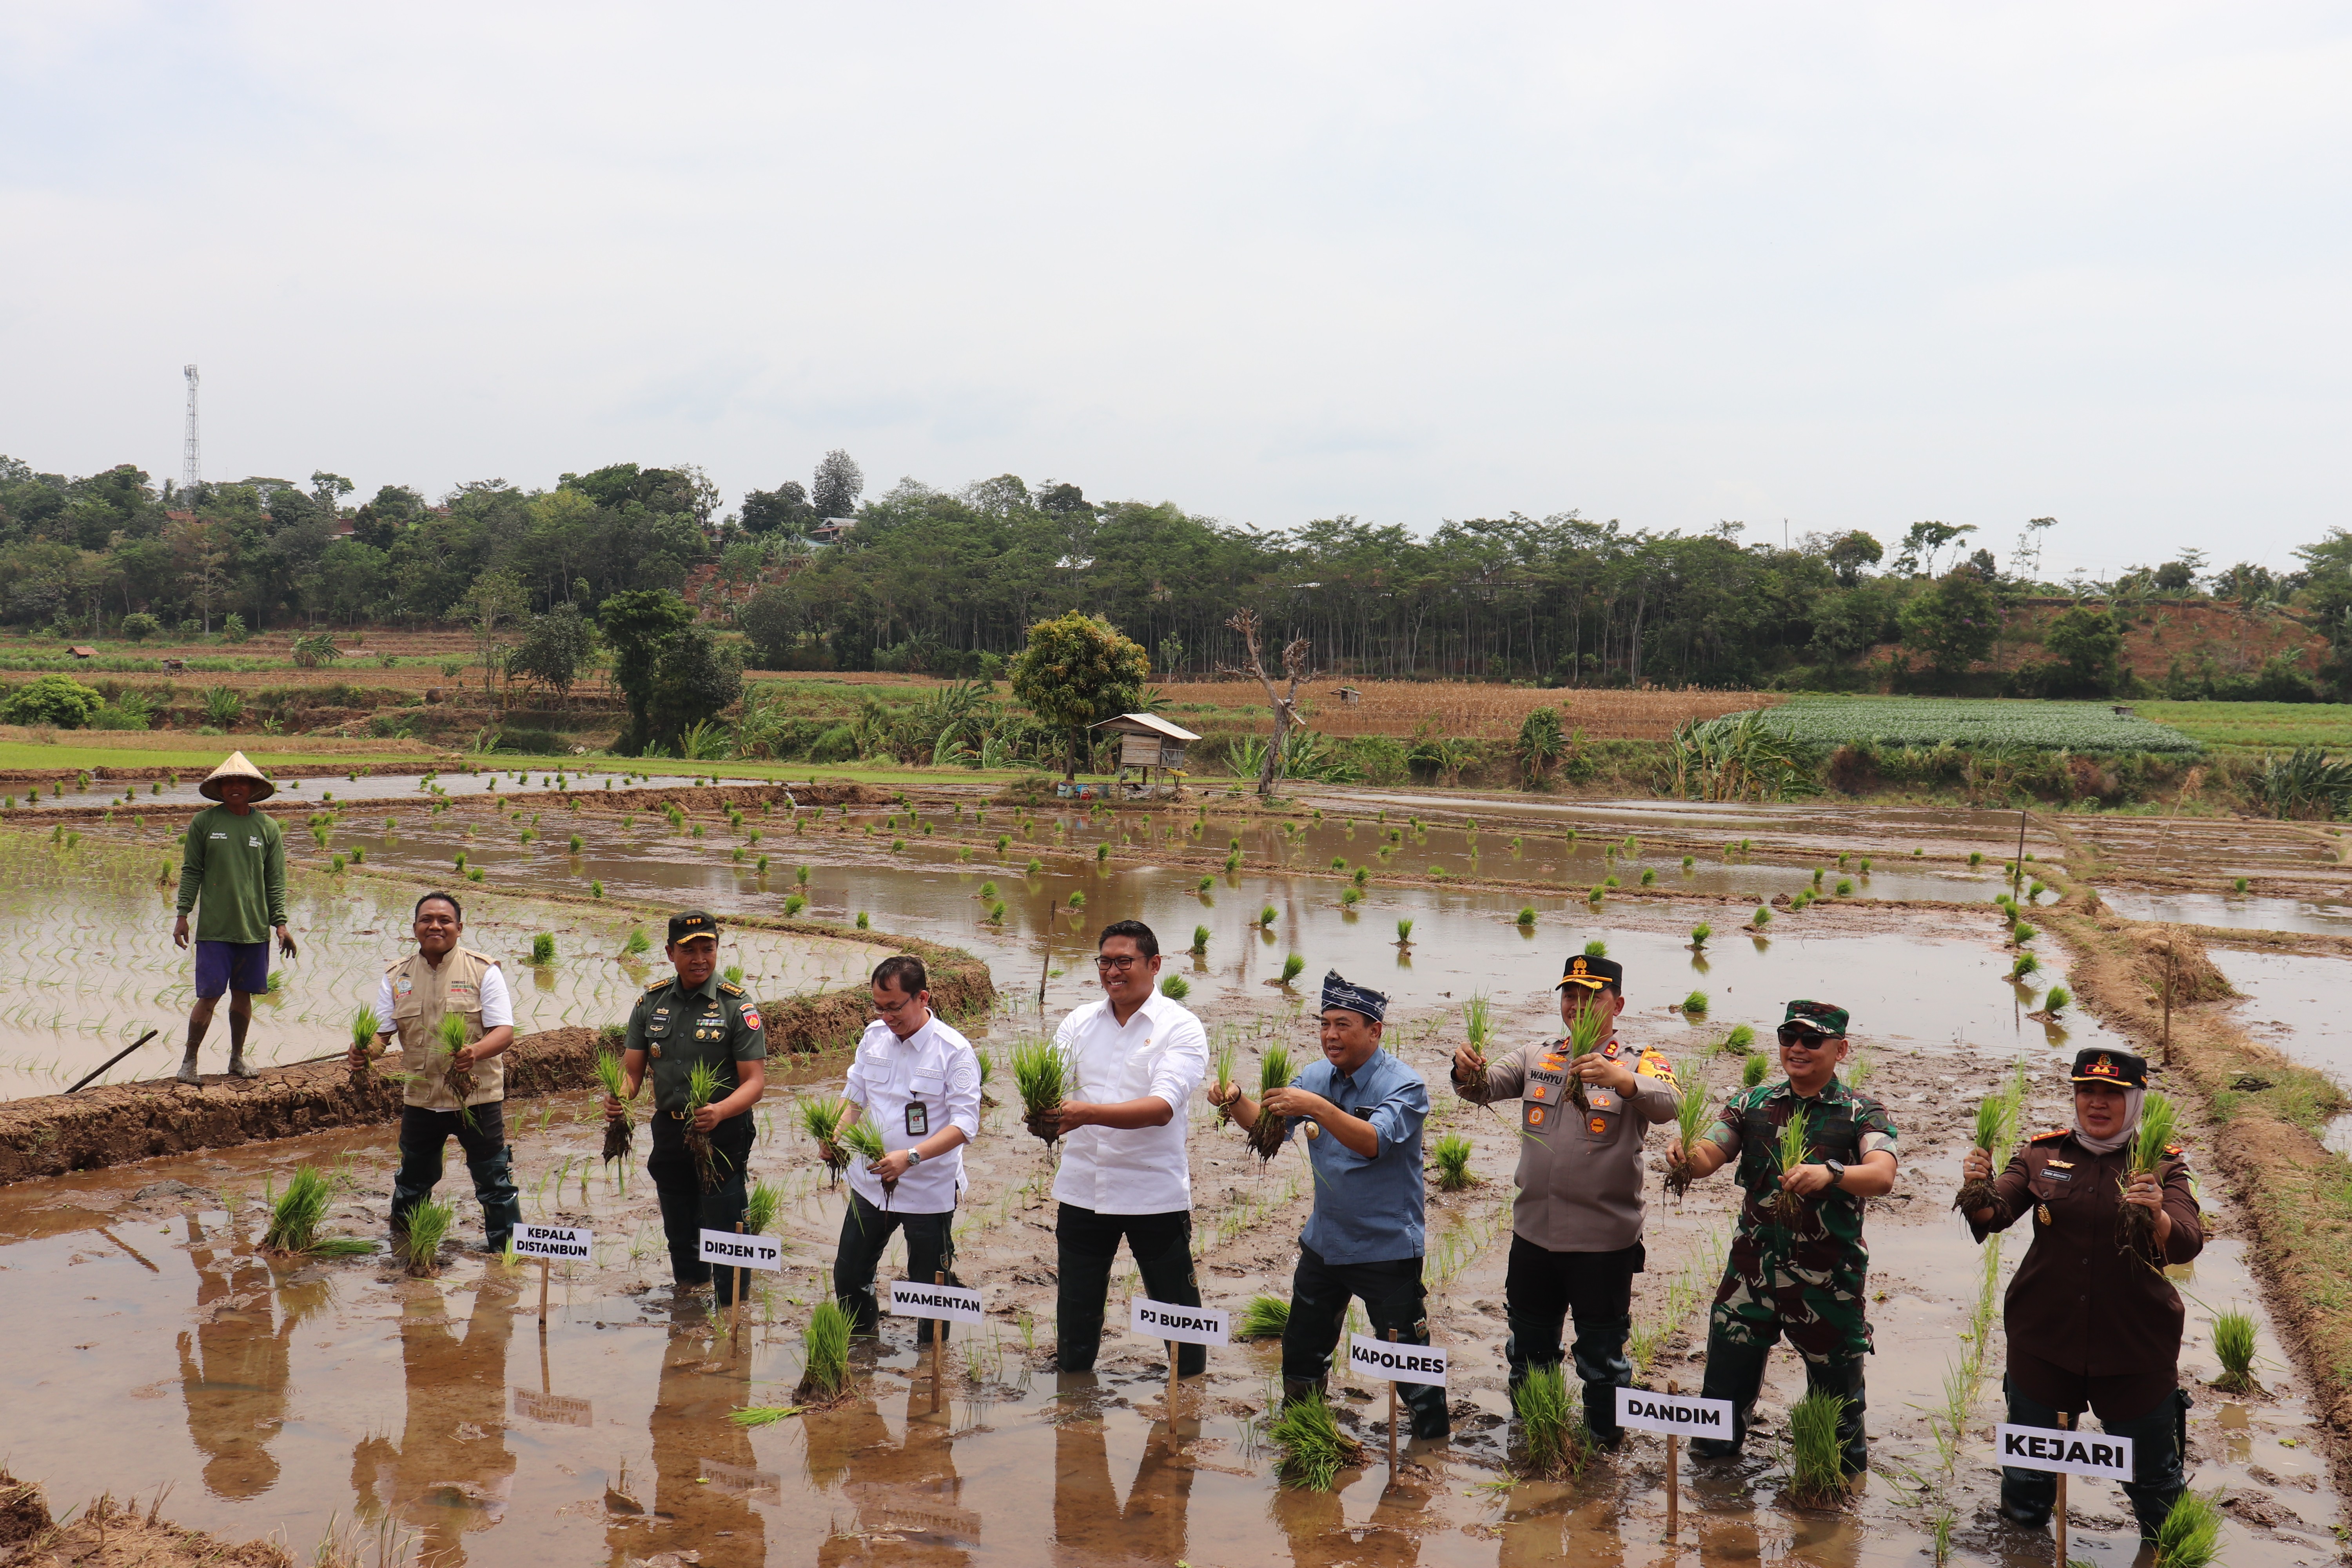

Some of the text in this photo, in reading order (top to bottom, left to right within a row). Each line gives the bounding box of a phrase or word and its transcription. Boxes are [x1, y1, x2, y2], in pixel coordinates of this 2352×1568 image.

[915, 1069, 941, 1077] DIRJEN
[1530, 1070, 1563, 1085] WAHYU
[528, 1227, 576, 1241] KEPALA
[517, 1240, 587, 1256] DISTANBUN
[705, 1241, 777, 1259] DIRJEN TP
[894, 1292, 980, 1312] WAMENTAN
[1141, 1309, 1218, 1332] PJ BUPATI
[1352, 1345, 1444, 1374] KAPOLRES
[1628, 1399, 1720, 1425] DANDIM
[2005, 1433, 2123, 1468] KEJARI
